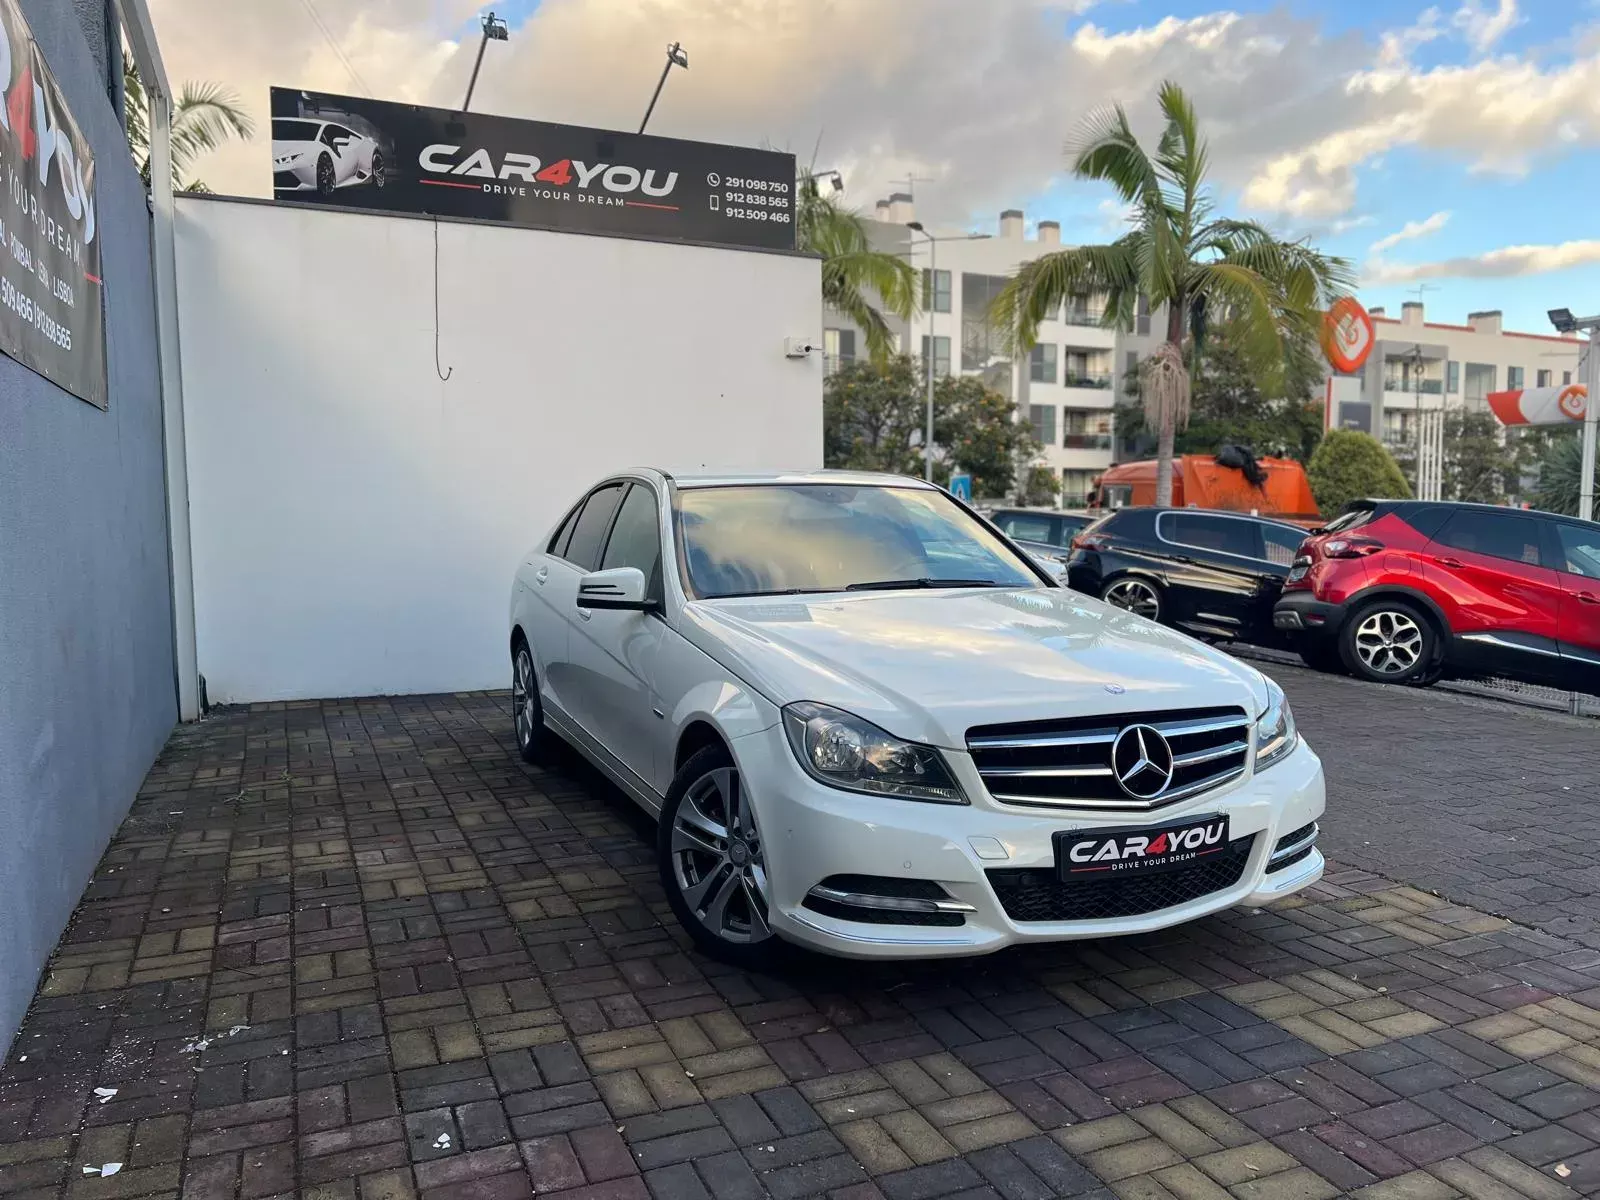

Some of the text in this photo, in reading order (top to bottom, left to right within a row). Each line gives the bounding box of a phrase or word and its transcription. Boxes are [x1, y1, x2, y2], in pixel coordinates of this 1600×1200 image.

[419, 144, 679, 197] CAR4YOU
[483, 184, 624, 206] DRIVE YOUR DREAM
[726, 176, 789, 193] 291 098 750
[726, 192, 789, 208] 912 838 565
[8, 163, 80, 266] YOUR DREAM
[726, 207, 790, 223] 912 509 466
[2, 276, 15, 311] 509
[16, 291, 33, 323] 466
[56, 324, 72, 351] 565
[1069, 822, 1225, 863] CAR4YOU
[1111, 852, 1196, 871] DRIVE YOUR DREAM
